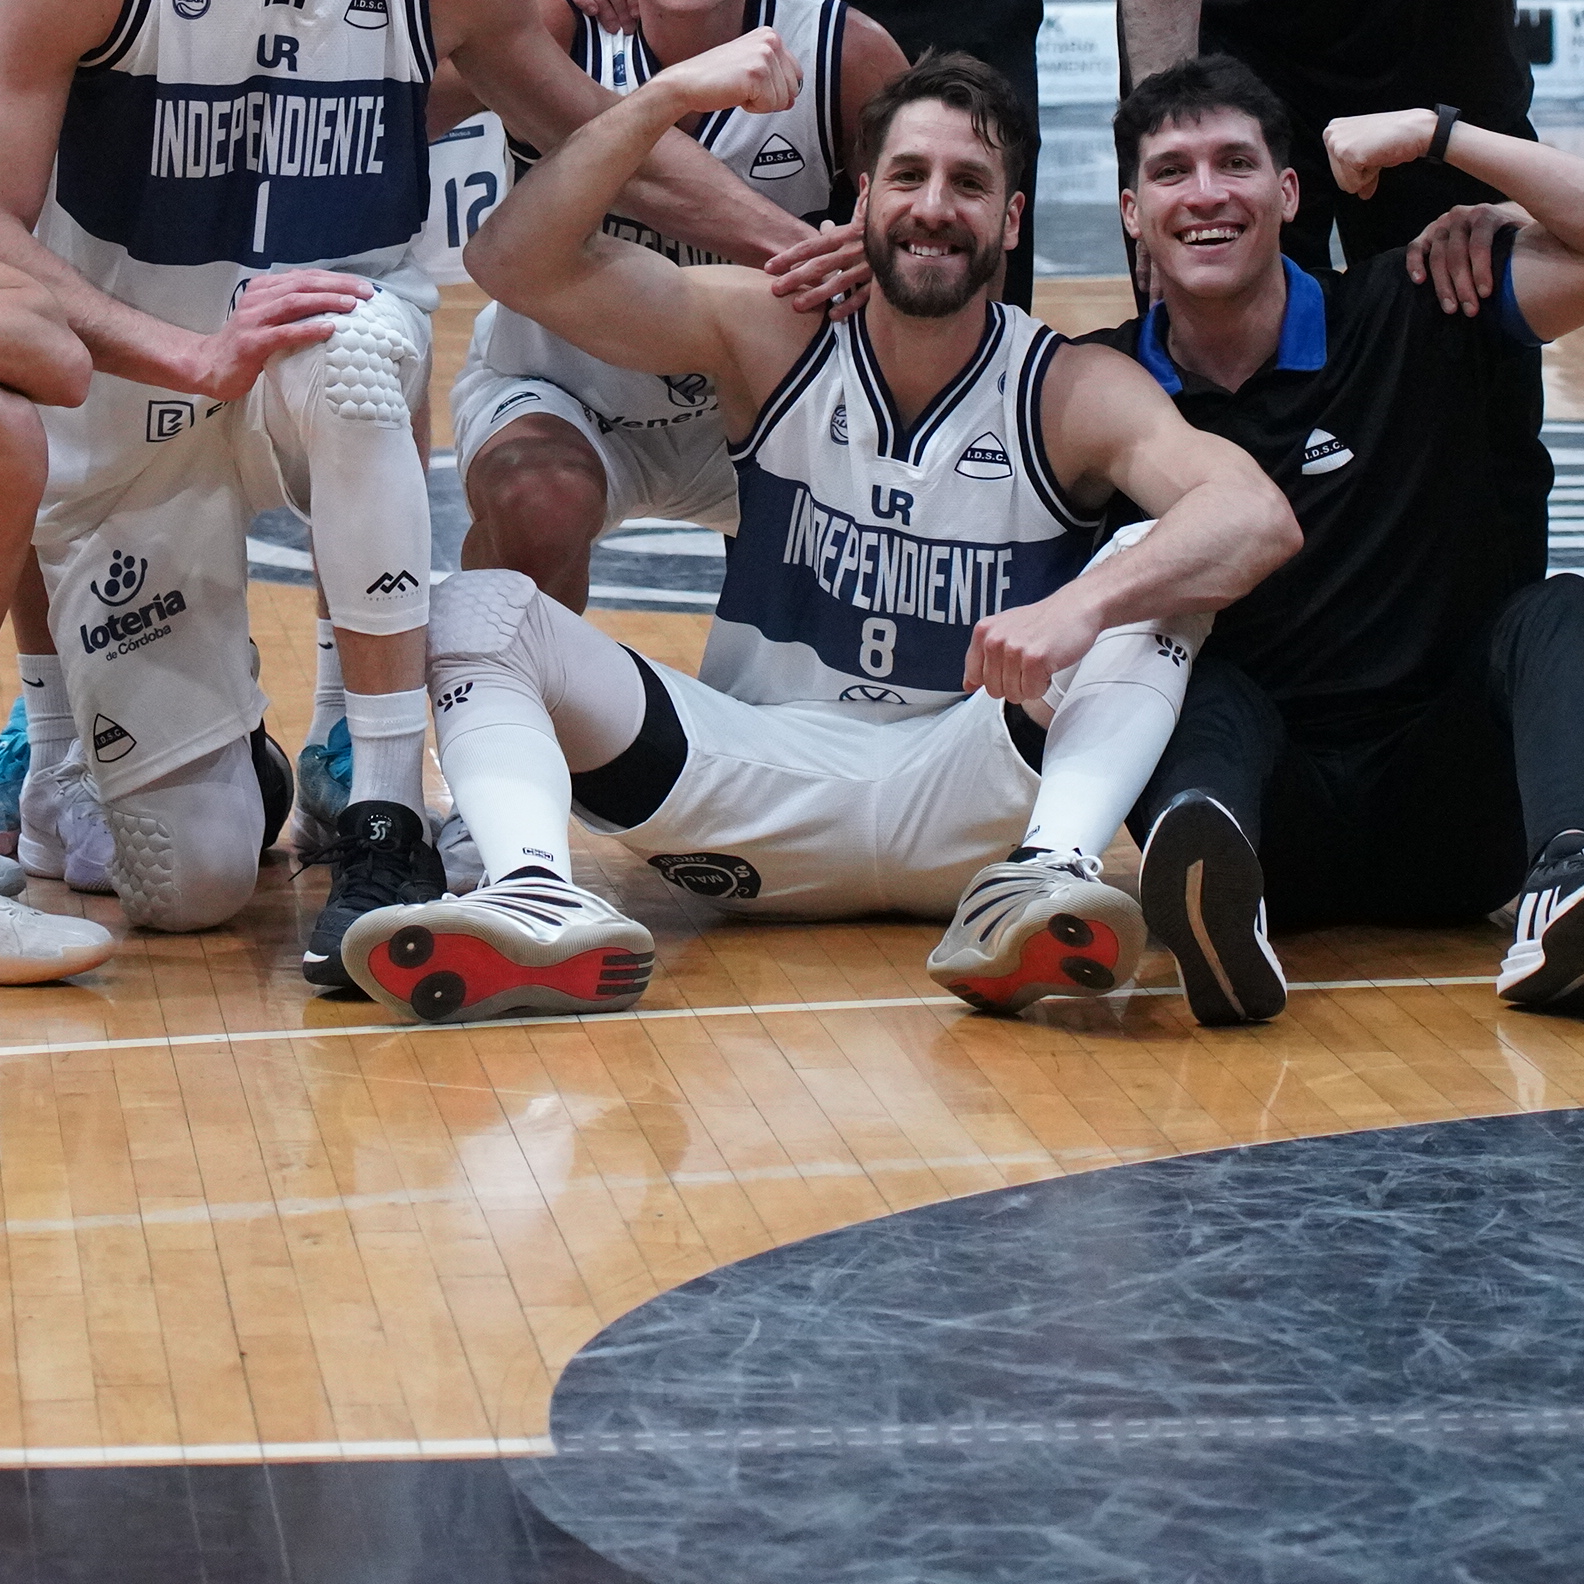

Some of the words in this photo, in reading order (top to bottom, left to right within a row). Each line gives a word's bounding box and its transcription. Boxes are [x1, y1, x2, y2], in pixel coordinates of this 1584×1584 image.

[353, 0, 386, 11] I.D.S.C.
[256, 33, 300, 72] UR
[149, 91, 386, 179] INDEPENDIENTE
[759, 152, 799, 164] I.D.S.C.
[252, 179, 271, 254] 1
[444, 170, 498, 248] 12
[966, 450, 1007, 462] I.D.S.C.
[1304, 441, 1344, 460] I.D.S.C.
[871, 484, 915, 527] UR
[117, 623, 173, 657] Córdoba
[859, 617, 898, 679] 8
